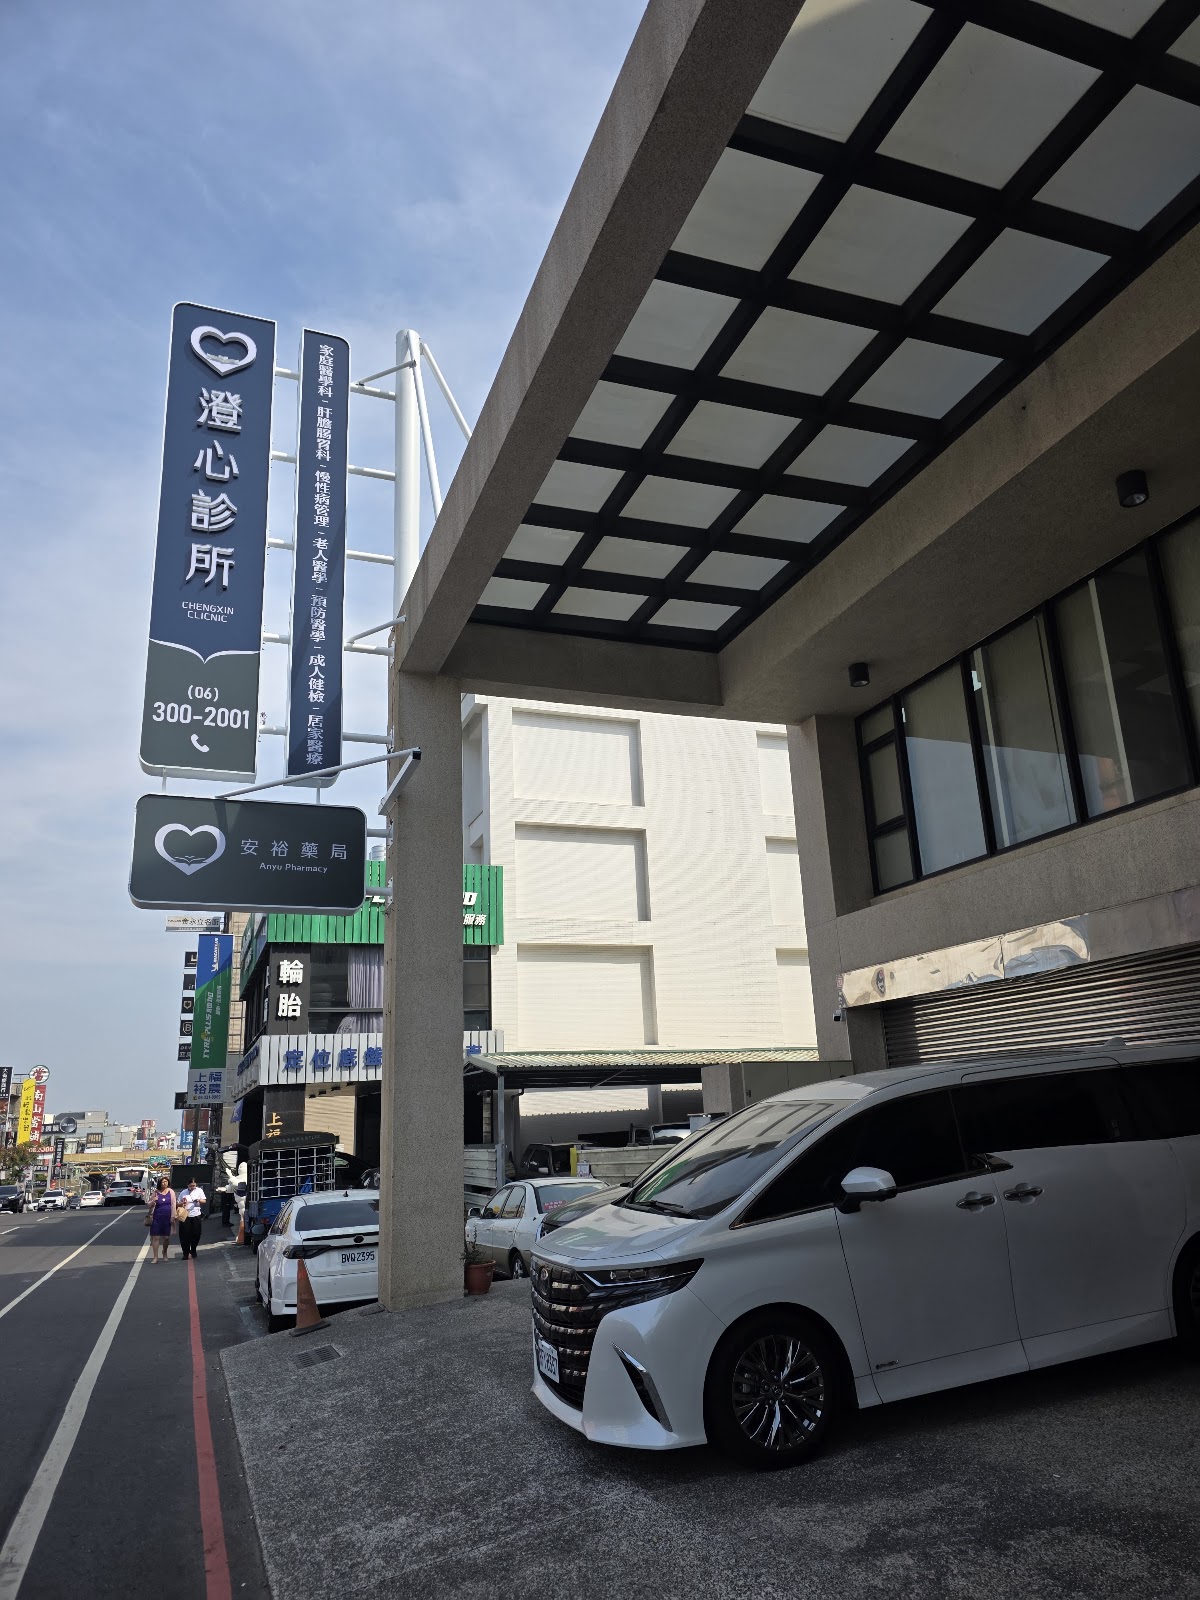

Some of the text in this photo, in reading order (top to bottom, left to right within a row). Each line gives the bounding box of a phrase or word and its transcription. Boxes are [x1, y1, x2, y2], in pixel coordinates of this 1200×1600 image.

[185, 386, 243, 590] 澄心診所
[306, 344, 334, 765] 家庭醫學科 肝膽腸胃科 慢性病管理 老人醫學 預防醫學 成人健檢 居家醫療
[182, 601, 234, 615] CHENGXIN
[187, 610, 228, 623] CLICNIC
[187, 684, 219, 702] (06)
[152, 701, 250, 730] 300-2001
[240, 838, 347, 860] 安裕藥局
[259, 862, 328, 874] Anyu Pharmacy
[277, 959, 304, 1018] 輪胎
[284, 1047, 382, 1070] 定位底盤
